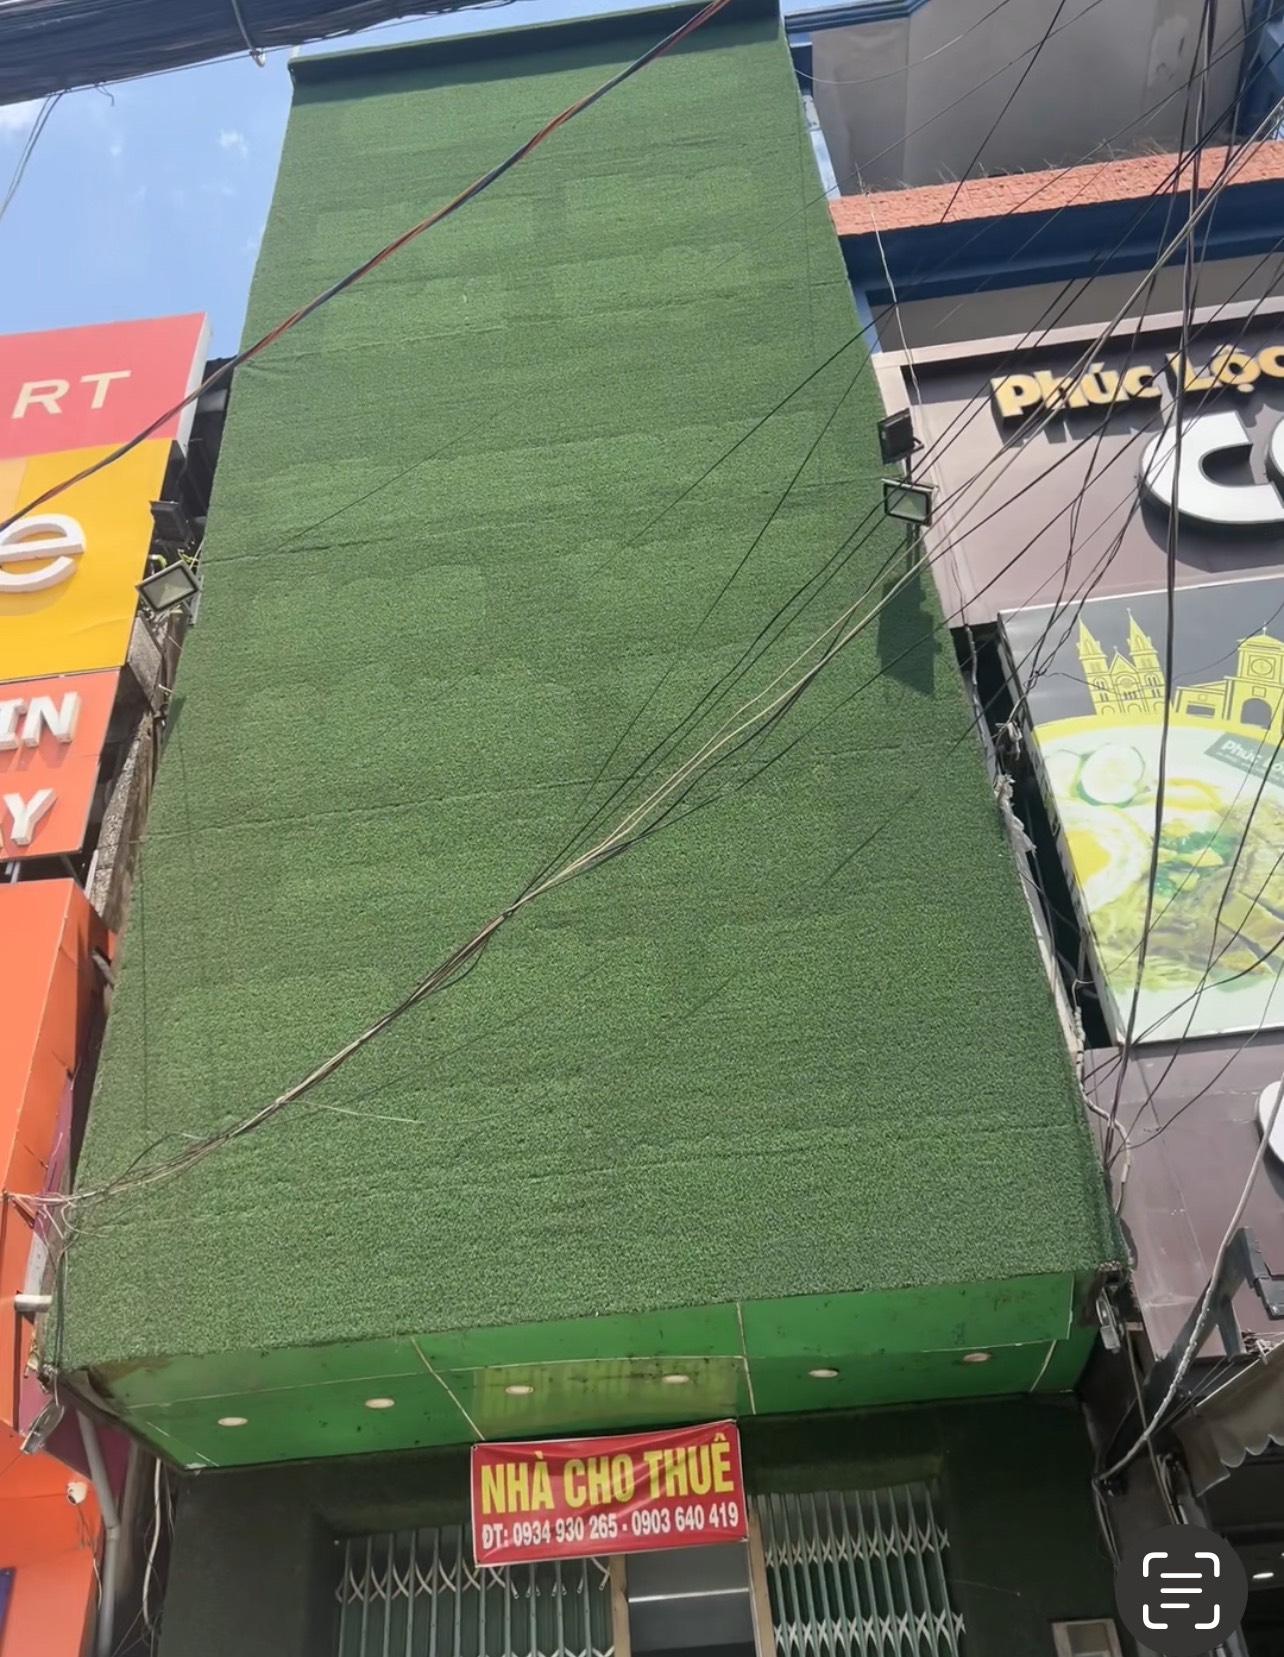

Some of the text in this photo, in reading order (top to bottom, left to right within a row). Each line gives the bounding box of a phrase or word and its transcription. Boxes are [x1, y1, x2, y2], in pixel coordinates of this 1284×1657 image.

[11, 369, 132, 420] RT
[990, 344, 1284, 418] Phúc Lộc
[1142, 408, 1284, 525] C
[0, 512, 87, 594] e
[0, 788, 58, 849] Y
[480, 1432, 735, 1515] NHÀ CHO THUÊ
[512, 1519, 552, 1547] 0934
[555, 1516, 585, 1543] 930
[588, 1512, 619, 1539] 265
[631, 1507, 672, 1537] 0903
[674, 1503, 706, 1533] 640
[708, 1501, 740, 1529] 419
